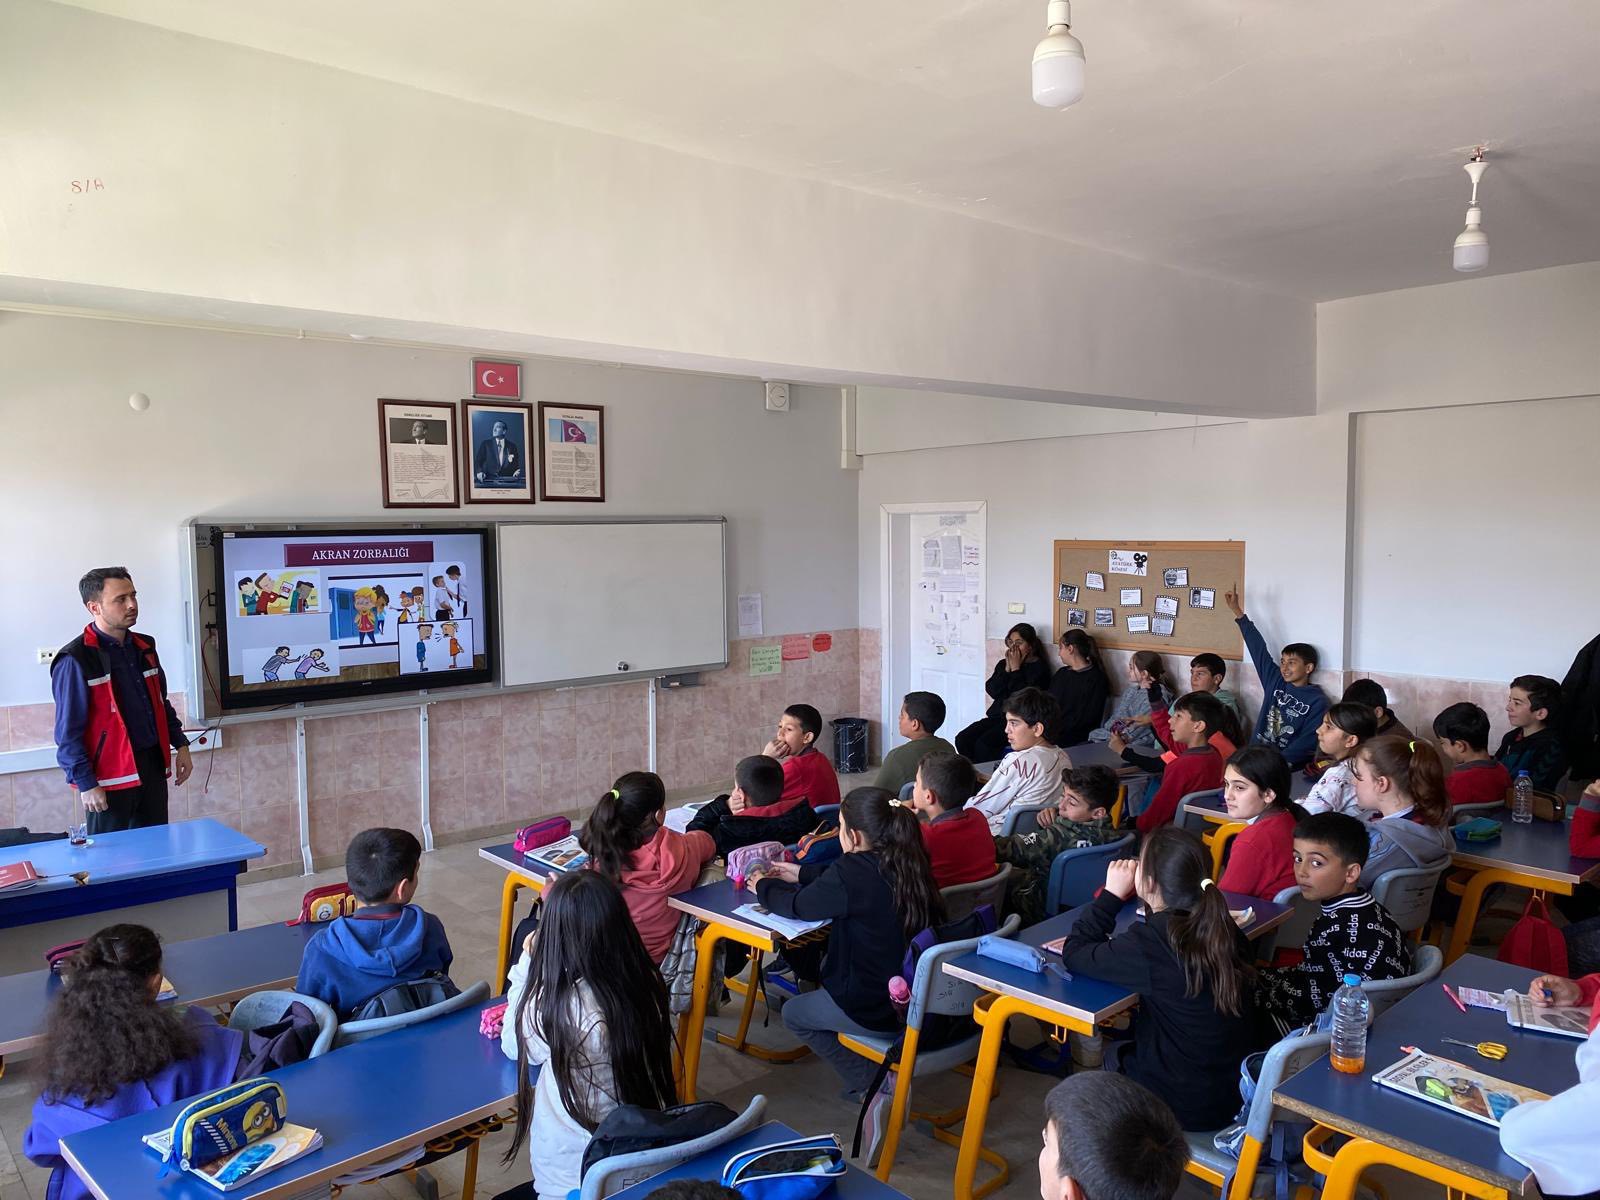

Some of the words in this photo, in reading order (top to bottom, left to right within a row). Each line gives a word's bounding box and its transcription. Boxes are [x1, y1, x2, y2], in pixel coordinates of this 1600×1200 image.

[312, 549, 351, 560] AKRAN
[352, 547, 409, 559] ZORBALIĞI
[1346, 913, 1359, 943] adidas
[1327, 952, 1344, 982] adidas
